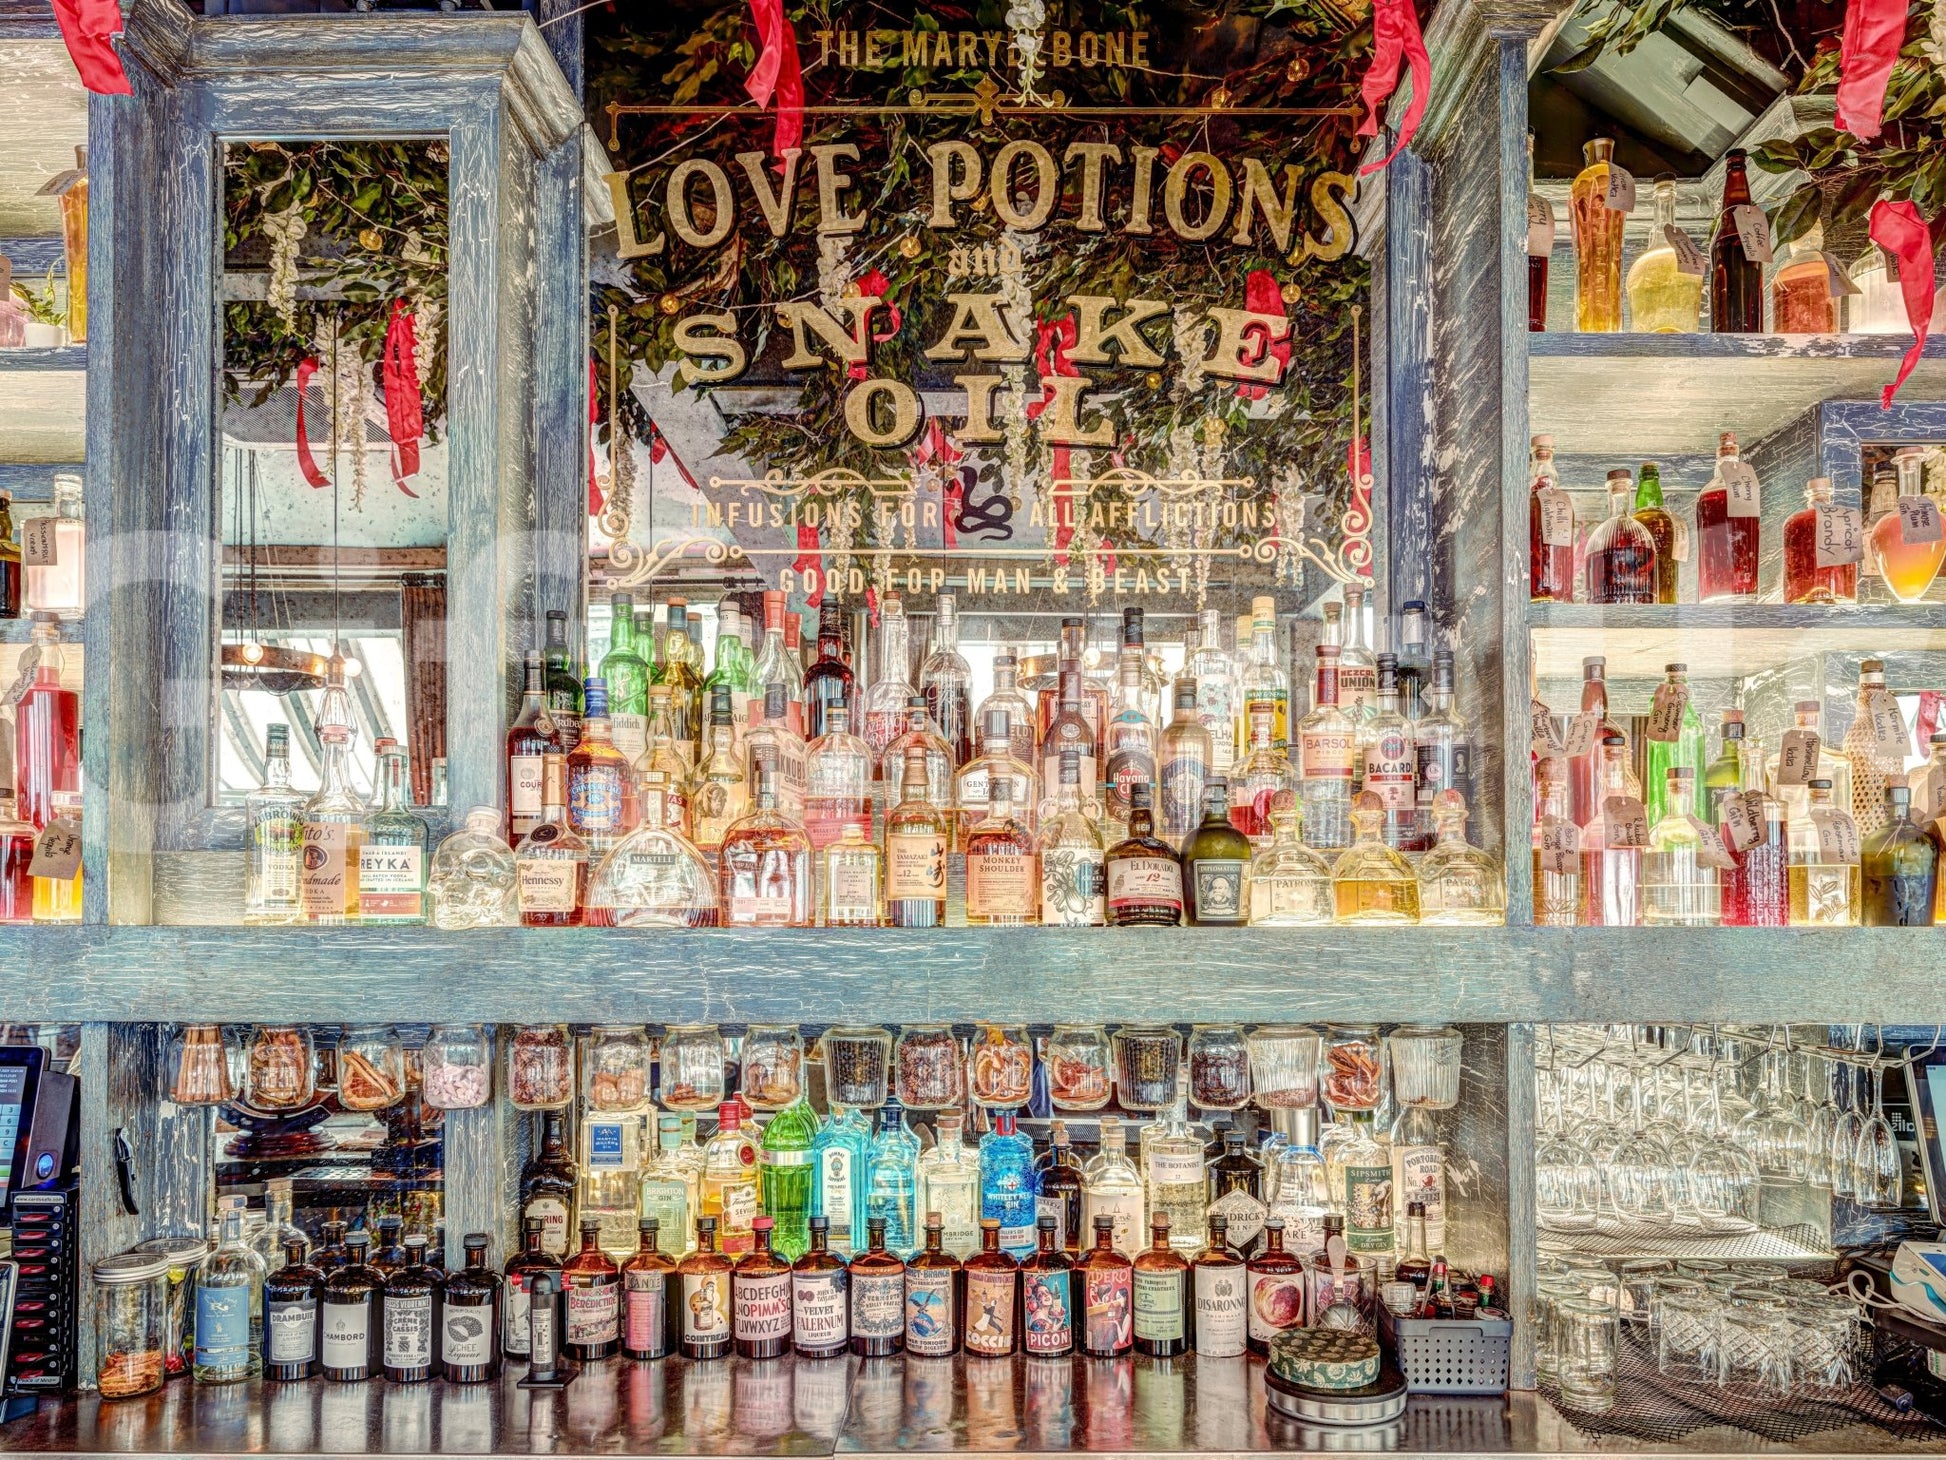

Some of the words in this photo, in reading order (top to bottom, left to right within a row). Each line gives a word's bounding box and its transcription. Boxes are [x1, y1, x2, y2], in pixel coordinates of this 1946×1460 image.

[819, 30, 882, 67] THE
[601, 142, 866, 261] LOVE
[926, 140, 1357, 264] POTIONS
[1752, 222, 1764, 248] Coffee
[947, 238, 1023, 277] and
[672, 291, 1294, 387] SNAKE
[844, 374, 1118, 447] OIL
[1741, 475, 1753, 501] Cherry
[693, 501, 863, 530] INFUSIONS
[880, 501, 939, 530] FOR
[1029, 501, 1078, 530] ALL
[1089, 501, 1277, 530] AFFLICTIONS
[1556, 501, 1567, 524] Chilli
[1900, 502, 1908, 516] Gin
[1819, 504, 1841, 557] Brandy
[1841, 508, 1858, 553] Apricot
[779, 567, 865, 595] GOOD
[966, 567, 1040, 595] MAN
[1051, 567, 1072, 595] &
[1085, 567, 1193, 595] BEAST
[1651, 709, 1662, 726] Gin
[1873, 711, 1887, 743] Vodka
[1306, 738, 1352, 749] BARSOL
[1786, 746, 1798, 767] Vodka
[1113, 772, 1150, 784] Havana
[1728, 806, 1741, 828] Gin
[1613, 823, 1622, 841] Gin
[1699, 828, 1710, 847] Gin
[59, 833, 80, 856] Orange
[1543, 834, 1552, 851] Gin
[632, 856, 674, 864] MARTELL
[979, 864, 1025, 873] SHOULDER
[983, 857, 1021, 865] MONKEY
[522, 874, 564, 889] Hennessy
[1146, 873, 1161, 883] 12
[1154, 1161, 1167, 1169] THE
[1168, 1161, 1200, 1169] BOTANIST
[1350, 1168, 1391, 1178] SIPSMITH
[646, 1186, 684, 1196] BRIGHTON
[1005, 1200, 1020, 1210] GIN
[1360, 1241, 1374, 1249] DRY
[272, 1311, 314, 1323] DRAMBUIE
[803, 1305, 835, 1316] VELVET
[392, 1325, 419, 1333] CASSIS
[796, 1314, 844, 1331] FALERNUM
[684, 1331, 729, 1343] COINTREAU
[1029, 1331, 1069, 1347] PICON
